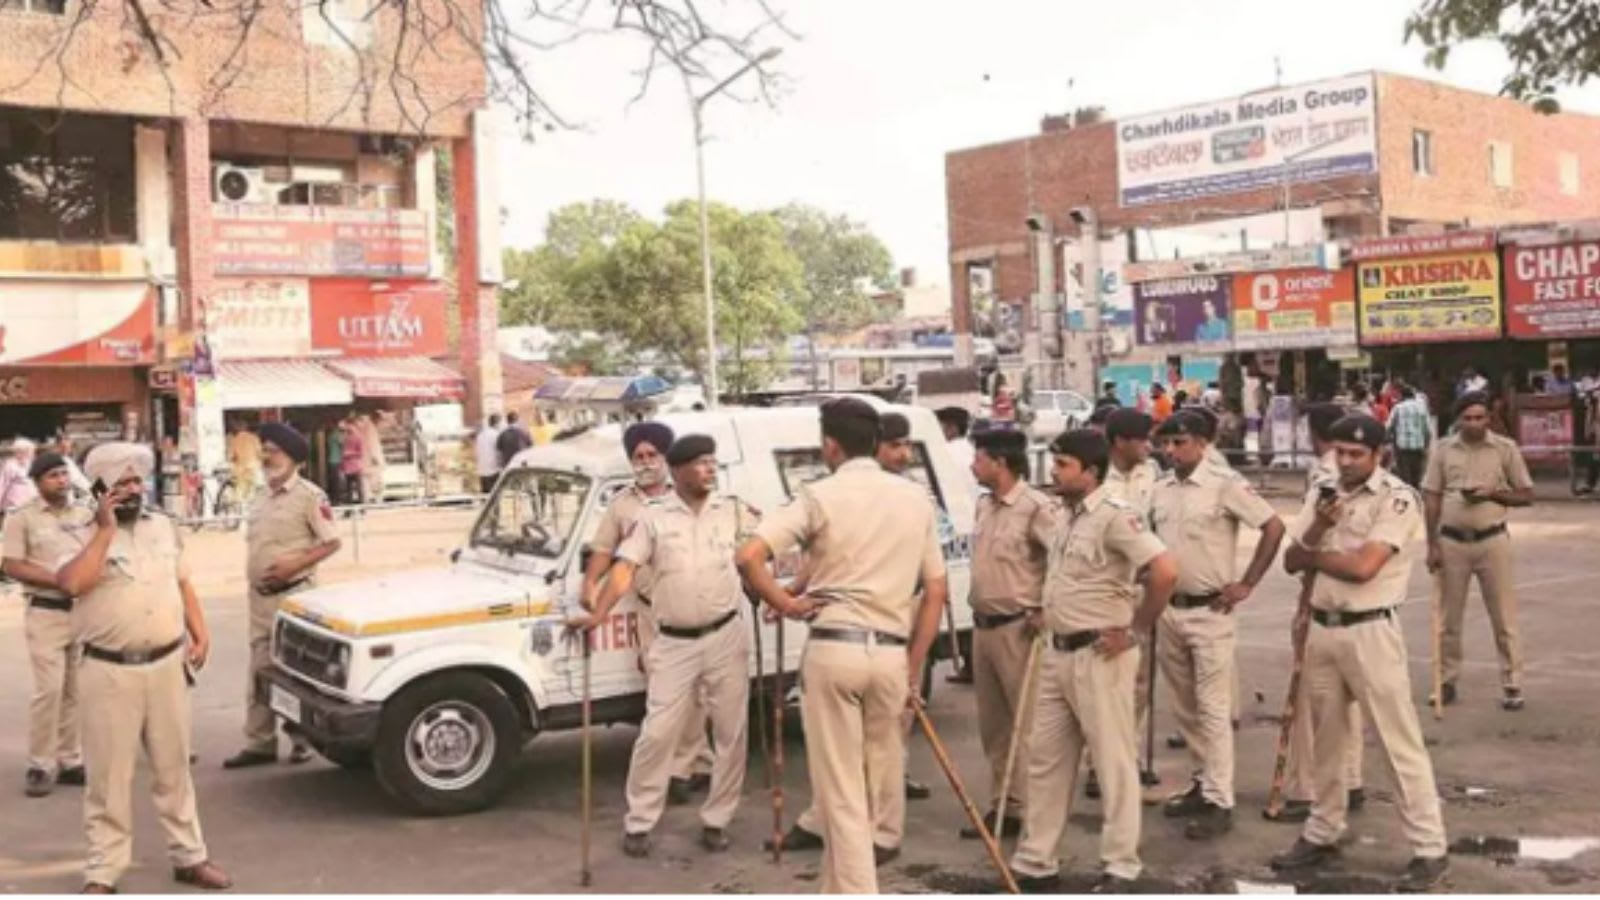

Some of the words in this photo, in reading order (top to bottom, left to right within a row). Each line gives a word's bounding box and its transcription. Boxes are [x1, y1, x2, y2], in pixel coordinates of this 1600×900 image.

[1121, 110, 1231, 142] Charhdikala
[1237, 95, 1297, 120] Media
[1304, 86, 1368, 110] Group
[1384, 257, 1493, 288] KRISHNA
[1515, 244, 1600, 280] CHAP
[1385, 288, 1424, 300] CHAT
[1534, 280, 1577, 300] FAST
[338, 314, 424, 339] UTTAM
